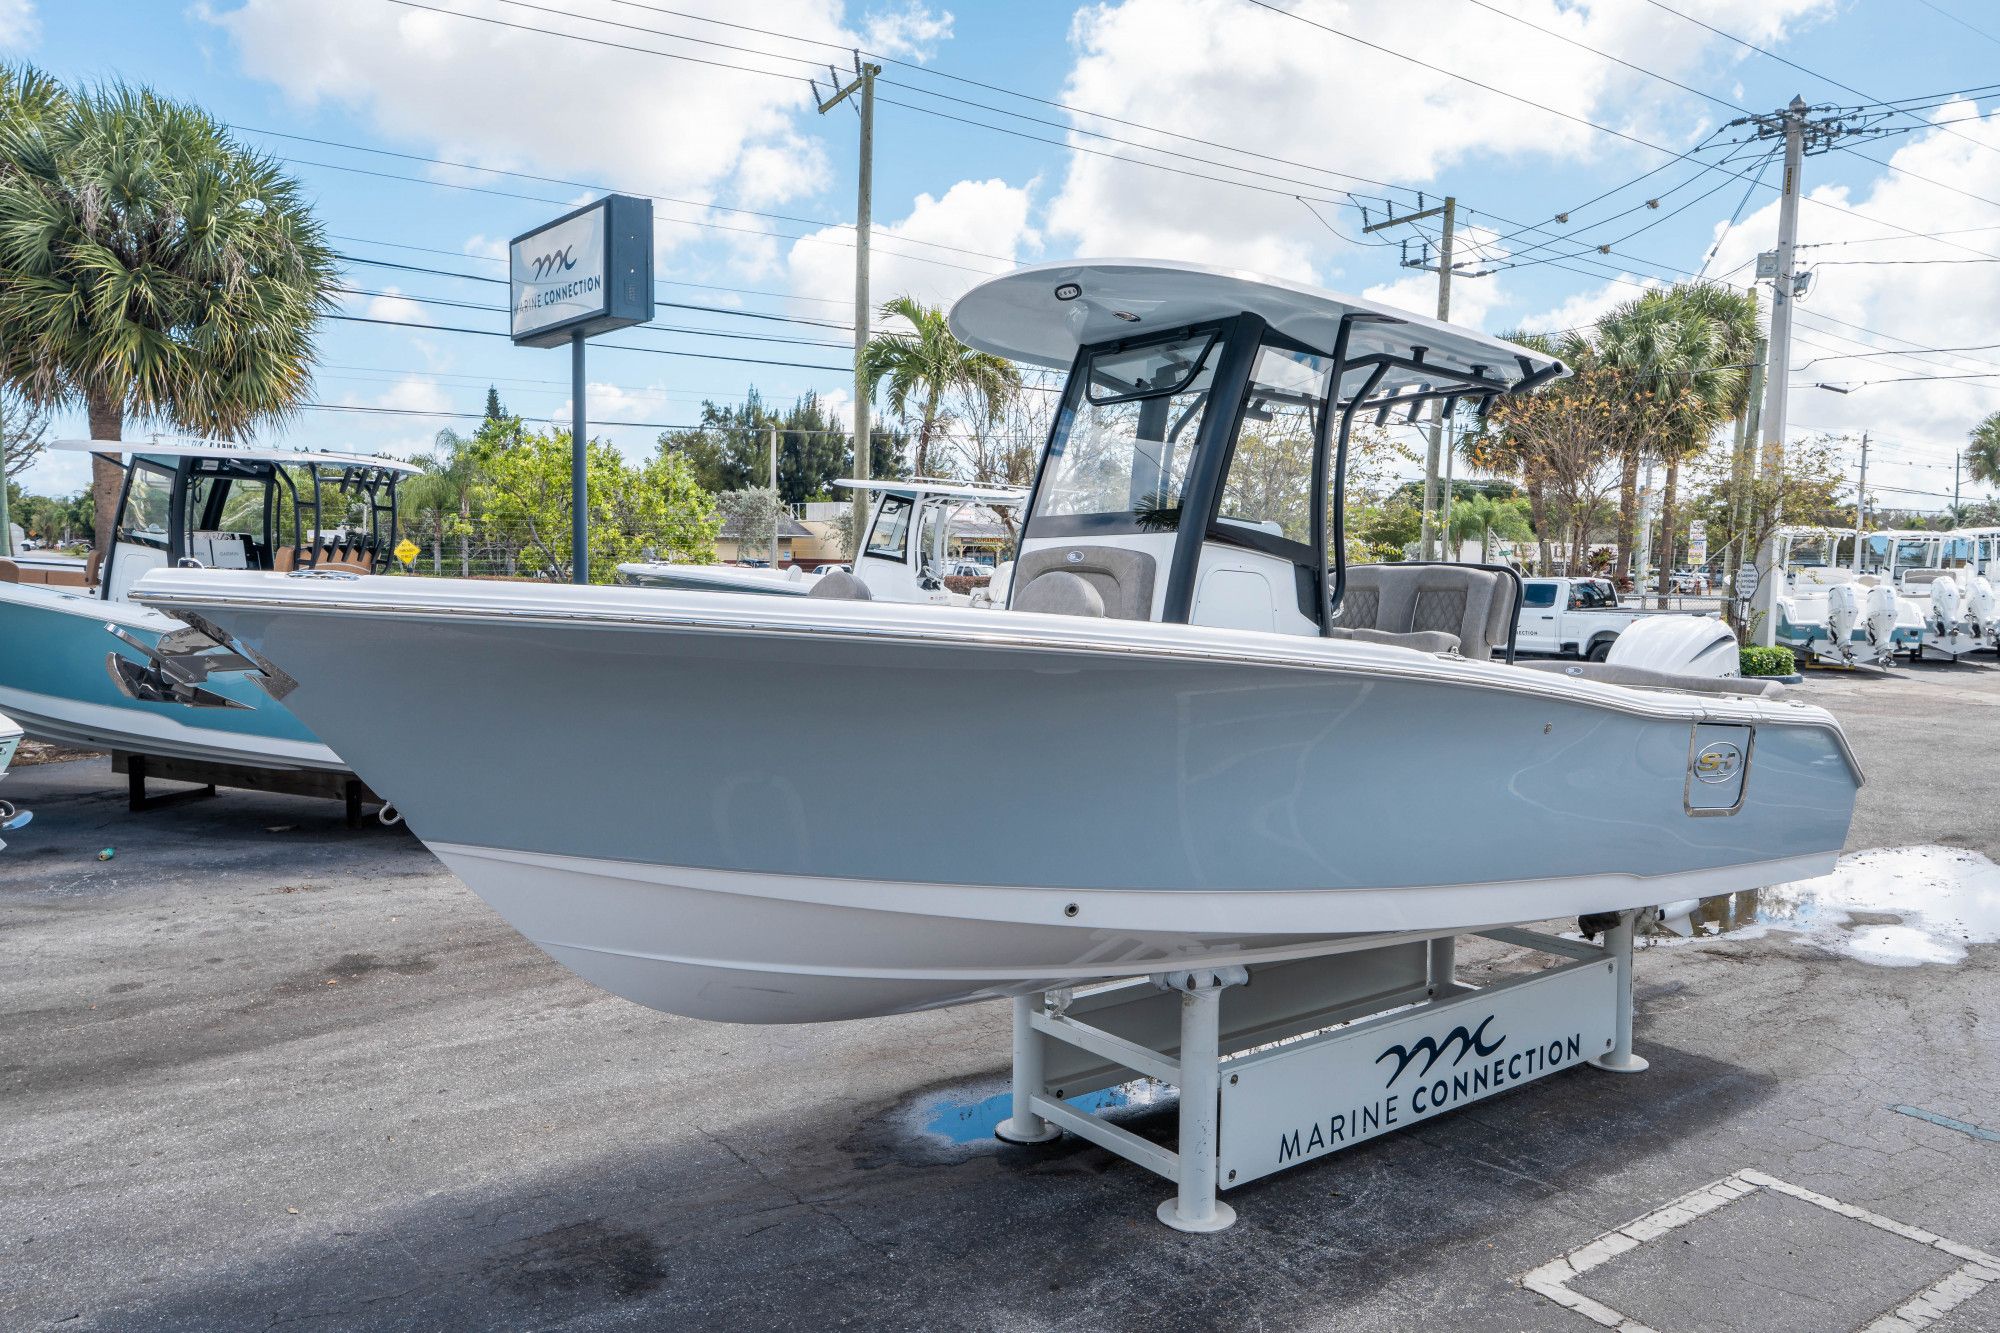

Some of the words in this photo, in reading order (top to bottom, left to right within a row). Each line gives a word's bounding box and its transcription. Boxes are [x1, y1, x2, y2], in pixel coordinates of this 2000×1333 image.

[514, 294, 542, 315] MARINE
[544, 274, 601, 306] CONNECTION
[1279, 1095, 1398, 1164] MARINE
[1412, 1033, 1581, 1114] CONNECTION
